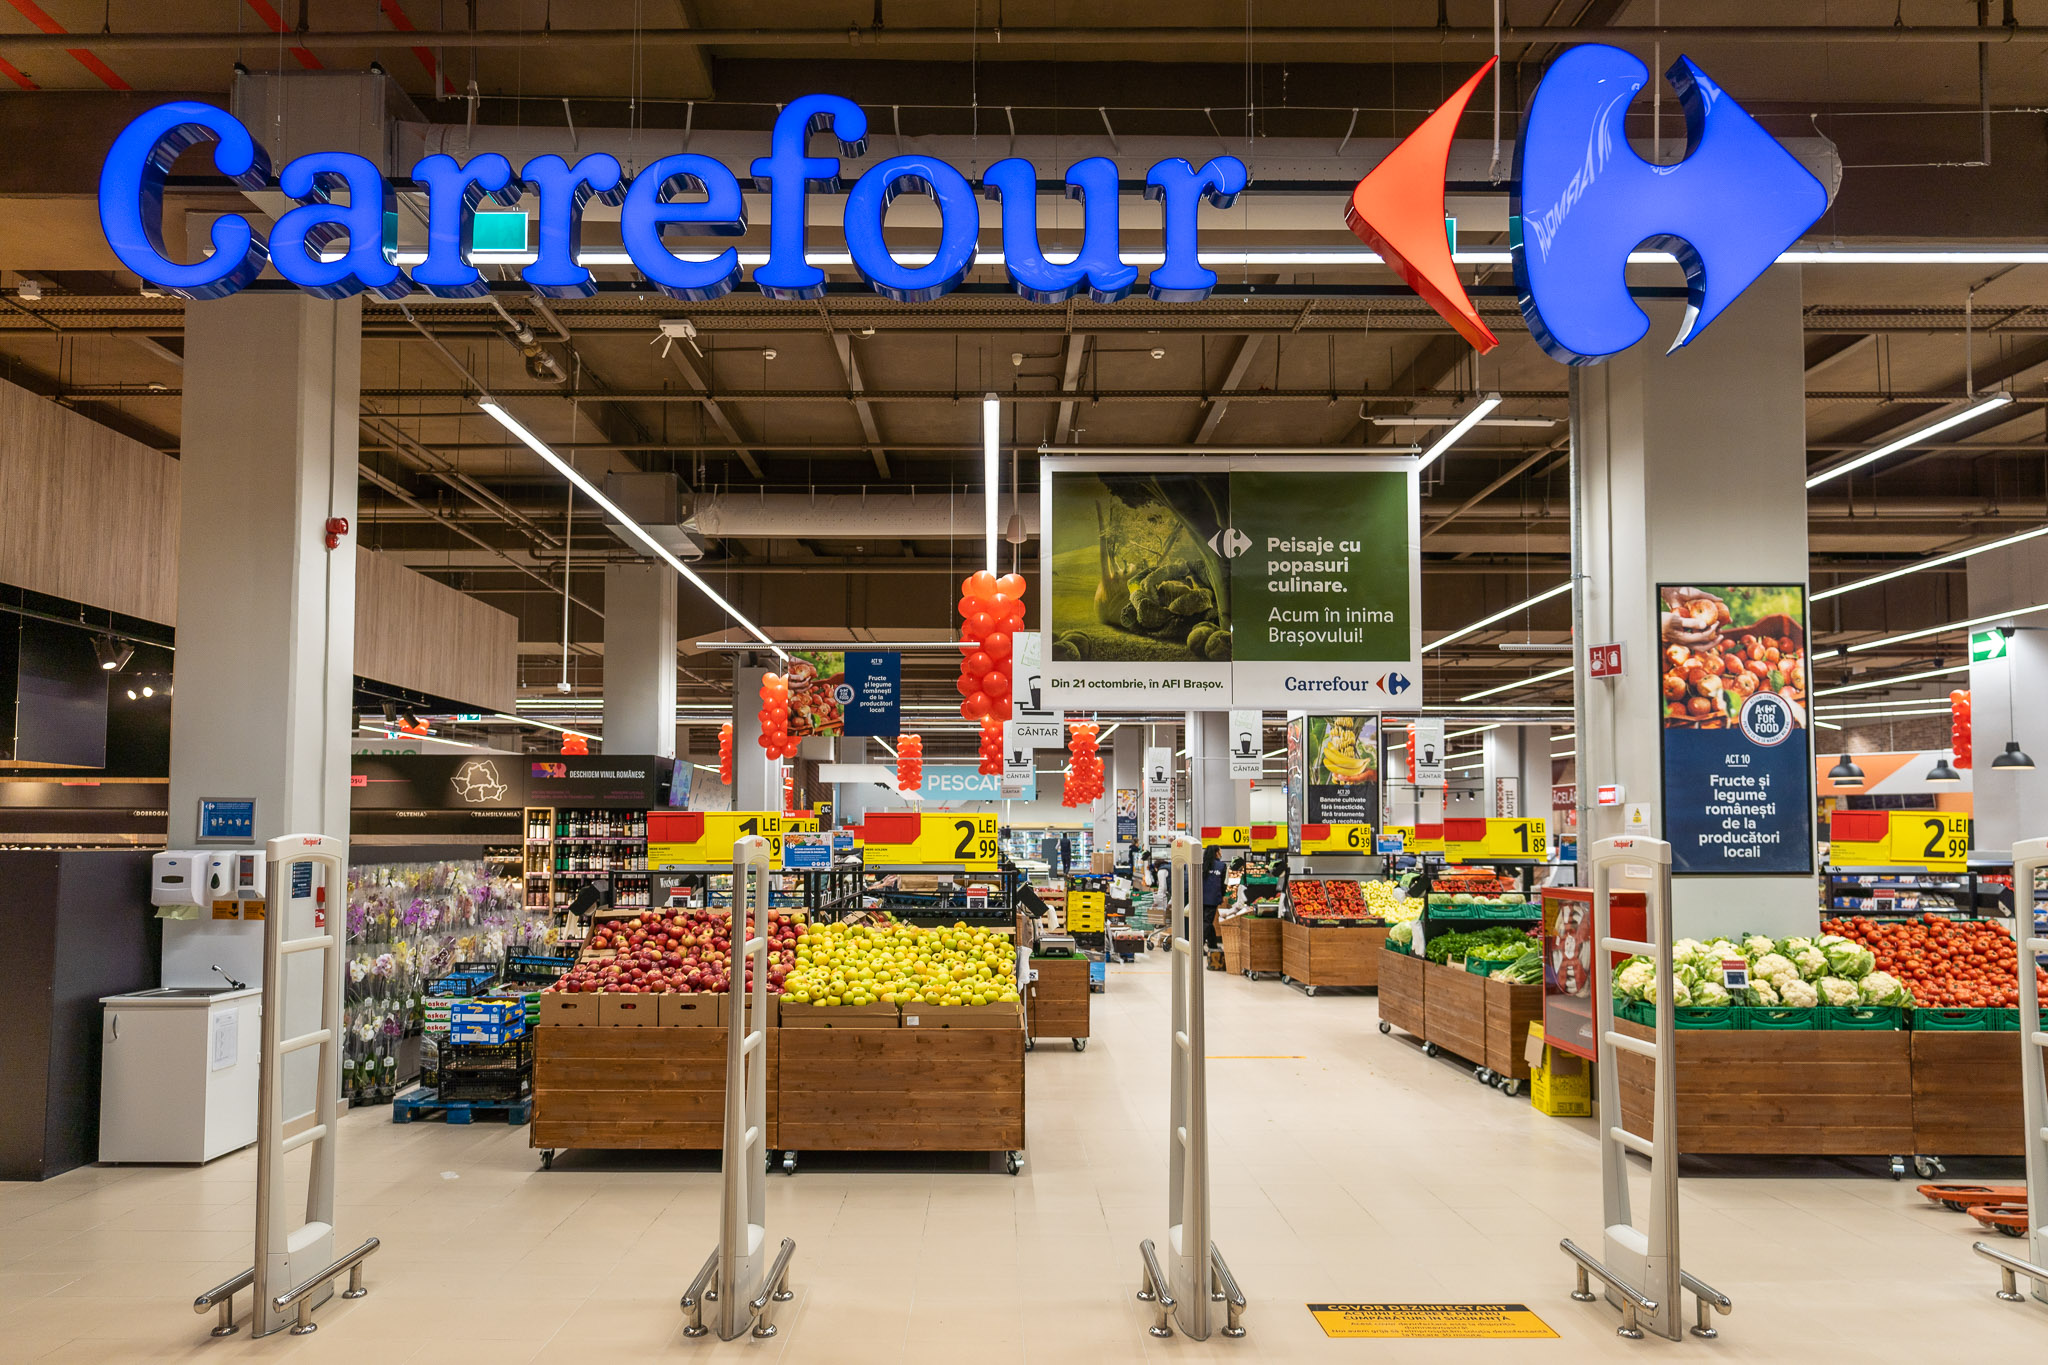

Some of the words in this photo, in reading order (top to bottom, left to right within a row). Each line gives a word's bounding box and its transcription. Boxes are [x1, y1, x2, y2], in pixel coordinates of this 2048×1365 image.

[99, 93, 1249, 300] Carrefour
[1267, 537, 1335, 556] Peisaje
[1338, 540, 1361, 554] cu
[1267, 557, 1349, 576] popasuri
[1267, 577, 1348, 593] culinare.
[1268, 608, 1320, 623] Acum
[1324, 607, 1341, 623] în
[1346, 607, 1394, 623] inima
[1268, 627, 1363, 646] Brașovului!
[1051, 678, 1070, 689] Din
[1072, 678, 1087, 689] 21
[1088, 678, 1146, 691] octombrie,
[1148, 677, 1160, 689] în
[1161, 678, 1181, 689] AFI
[1183, 678, 1224, 692] Brașov.
[1284, 676, 1369, 692] Carrefour
[1757, 714, 1776, 723] FOR
[1017, 726, 1058, 736] CÂNTAR
[1755, 723, 1779, 733] FOOD
[1725, 754, 1739, 765] ACT
[1740, 754, 1750, 765] 10
[569, 770, 600, 779] DESCHIDEM
[600, 771, 616, 779] VINUL
[1233, 764, 1260, 772] CÂNTAR
[1710, 775, 1755, 787] Fructe
[1758, 775, 1770, 791] și
[1714, 788, 1767, 804] legume
[1705, 803, 1776, 819] românești
[763, 818, 780, 831] LEI
[979, 819, 996, 833] LEI
[1530, 823, 1544, 833] LEI
[1722, 817, 1737, 830] de
[1740, 817, 1757, 830] la
[1948, 819, 1967, 833] LEI
[954, 820, 976, 859] 2
[1233, 829, 1241, 843] 0
[1347, 828, 1360, 847] 6
[1361, 837, 1370, 847] 39
[1513, 823, 1528, 852] 1
[1699, 831, 1781, 848] producători
[1923, 818, 1946, 858] 2
[979, 839, 996, 858] 99
[1533, 838, 1546, 853] 89
[1723, 845, 1761, 858] locali
[1948, 839, 1967, 857] 99
